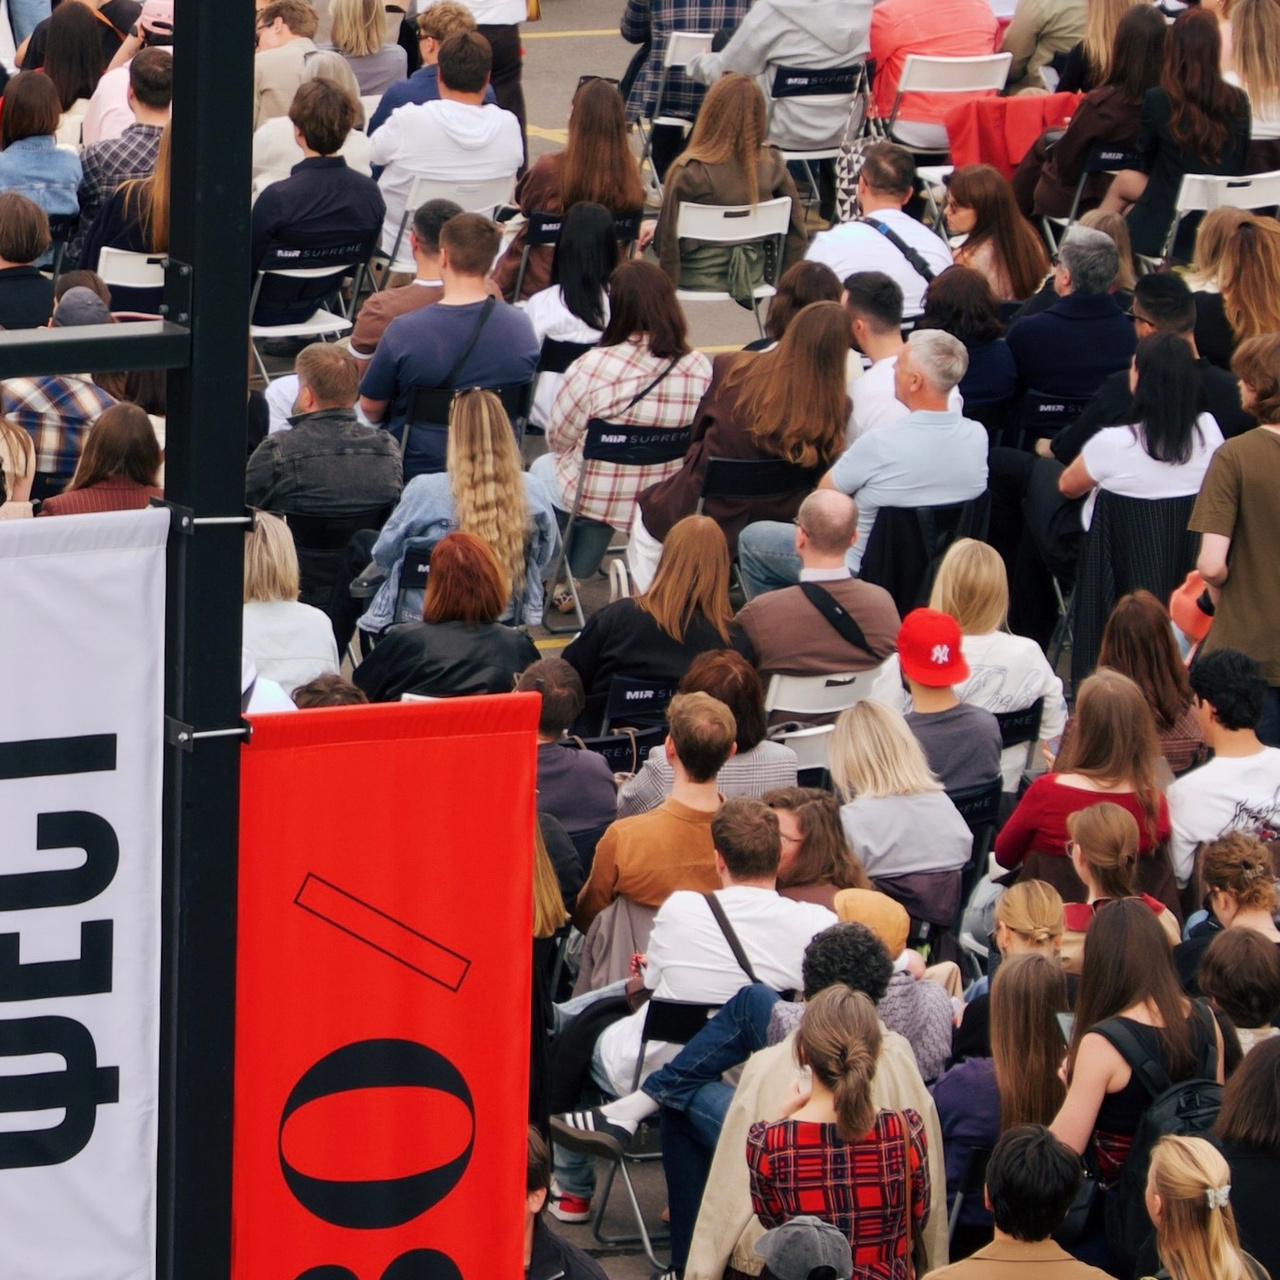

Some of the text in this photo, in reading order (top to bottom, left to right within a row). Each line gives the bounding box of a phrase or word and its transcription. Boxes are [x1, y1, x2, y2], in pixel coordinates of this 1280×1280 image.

[811, 74, 858, 84] SUPRE
[277, 243, 362, 258] MIR SUPREME
[1040, 404, 1064, 412] MIR
[601, 432, 689, 443] MIR SUPREM
[626, 690, 654, 699] MIR
